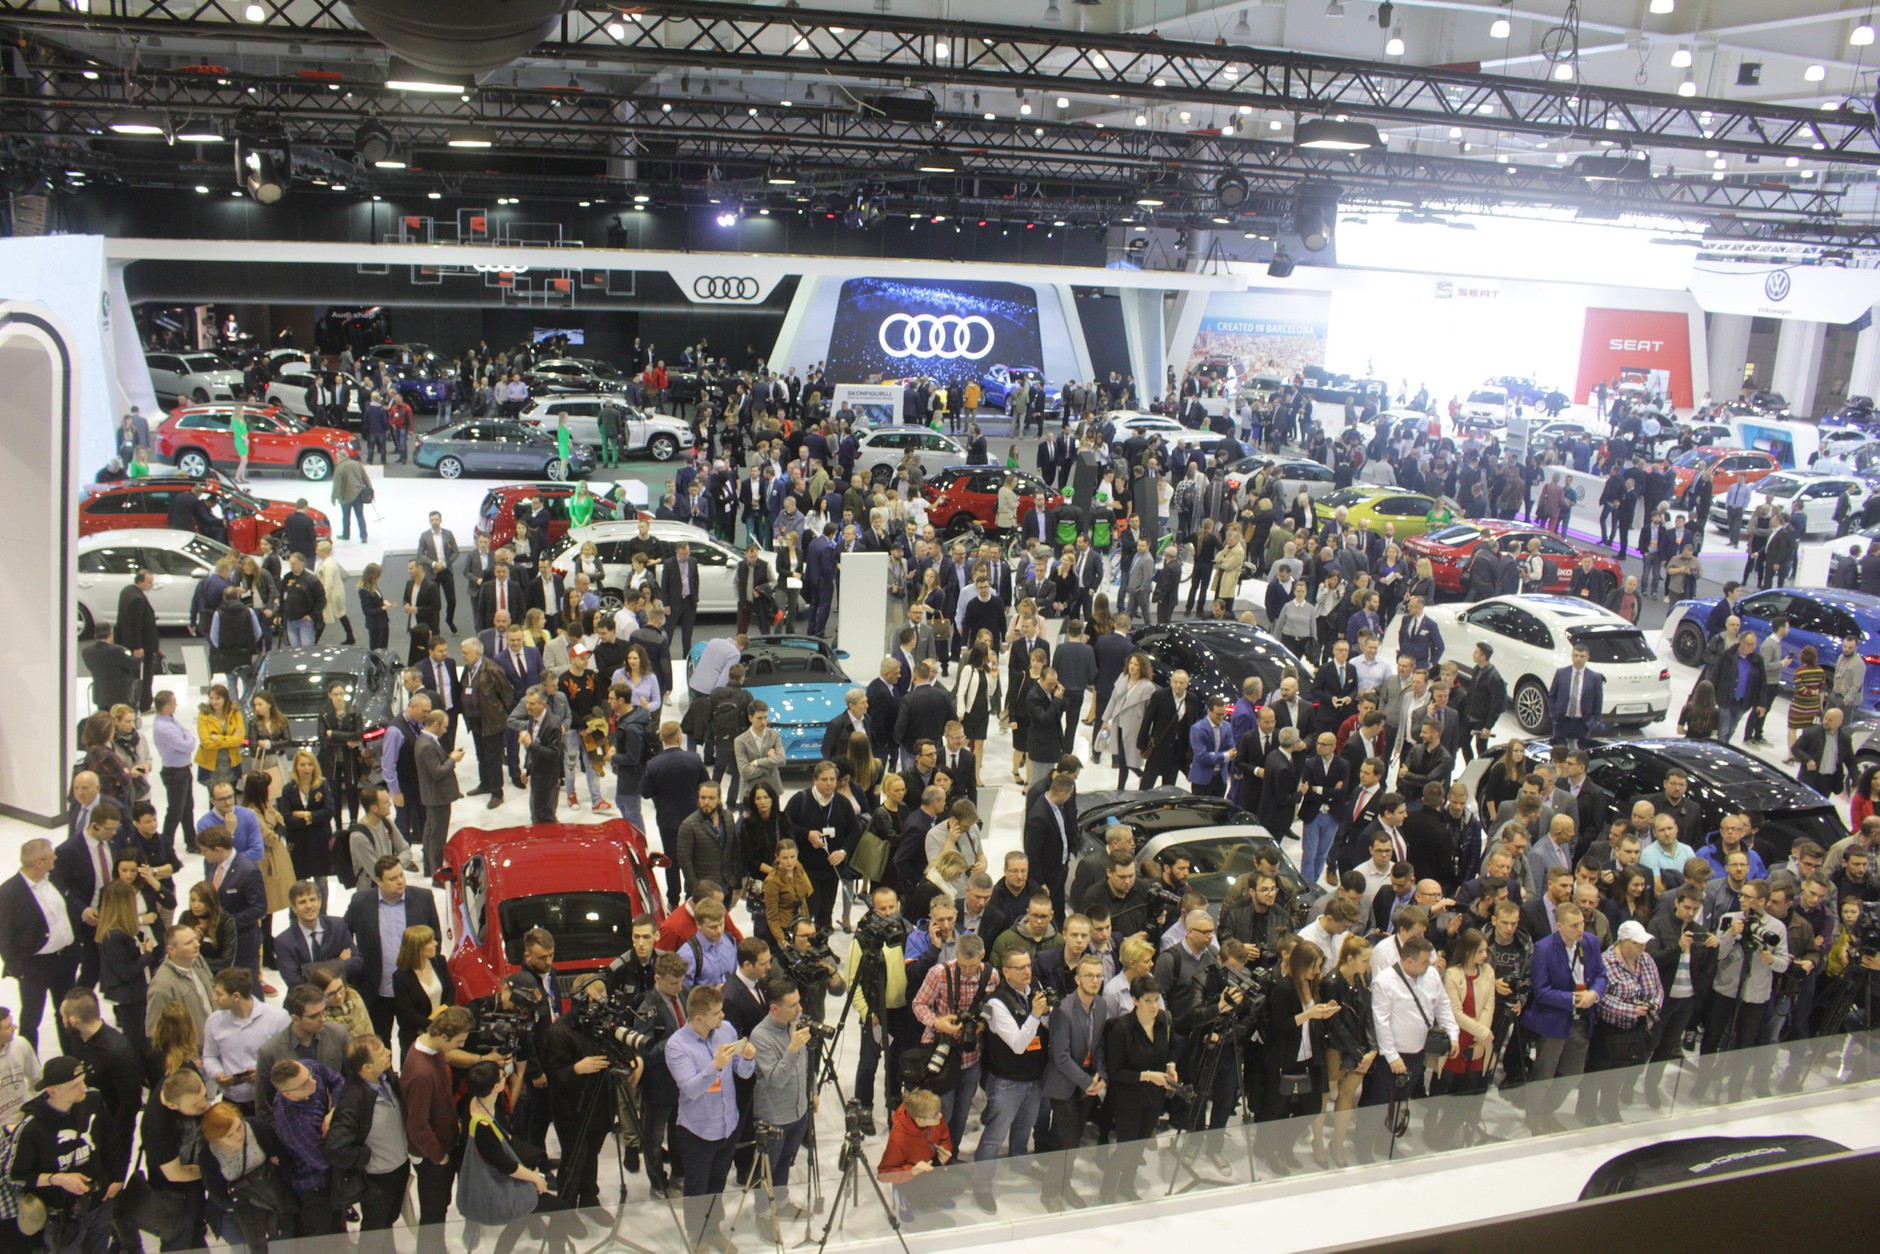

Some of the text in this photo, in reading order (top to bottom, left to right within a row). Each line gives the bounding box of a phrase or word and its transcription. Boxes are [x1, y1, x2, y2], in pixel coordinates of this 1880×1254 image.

[1458, 288, 1500, 298] SEAT
[331, 311, 375, 320] Audi shop
[1217, 321, 1315, 335] CREATED IN BARCELONA
[1609, 338, 1665, 352] SEAT
[1688, 1146, 1787, 1173] PORSCHE
